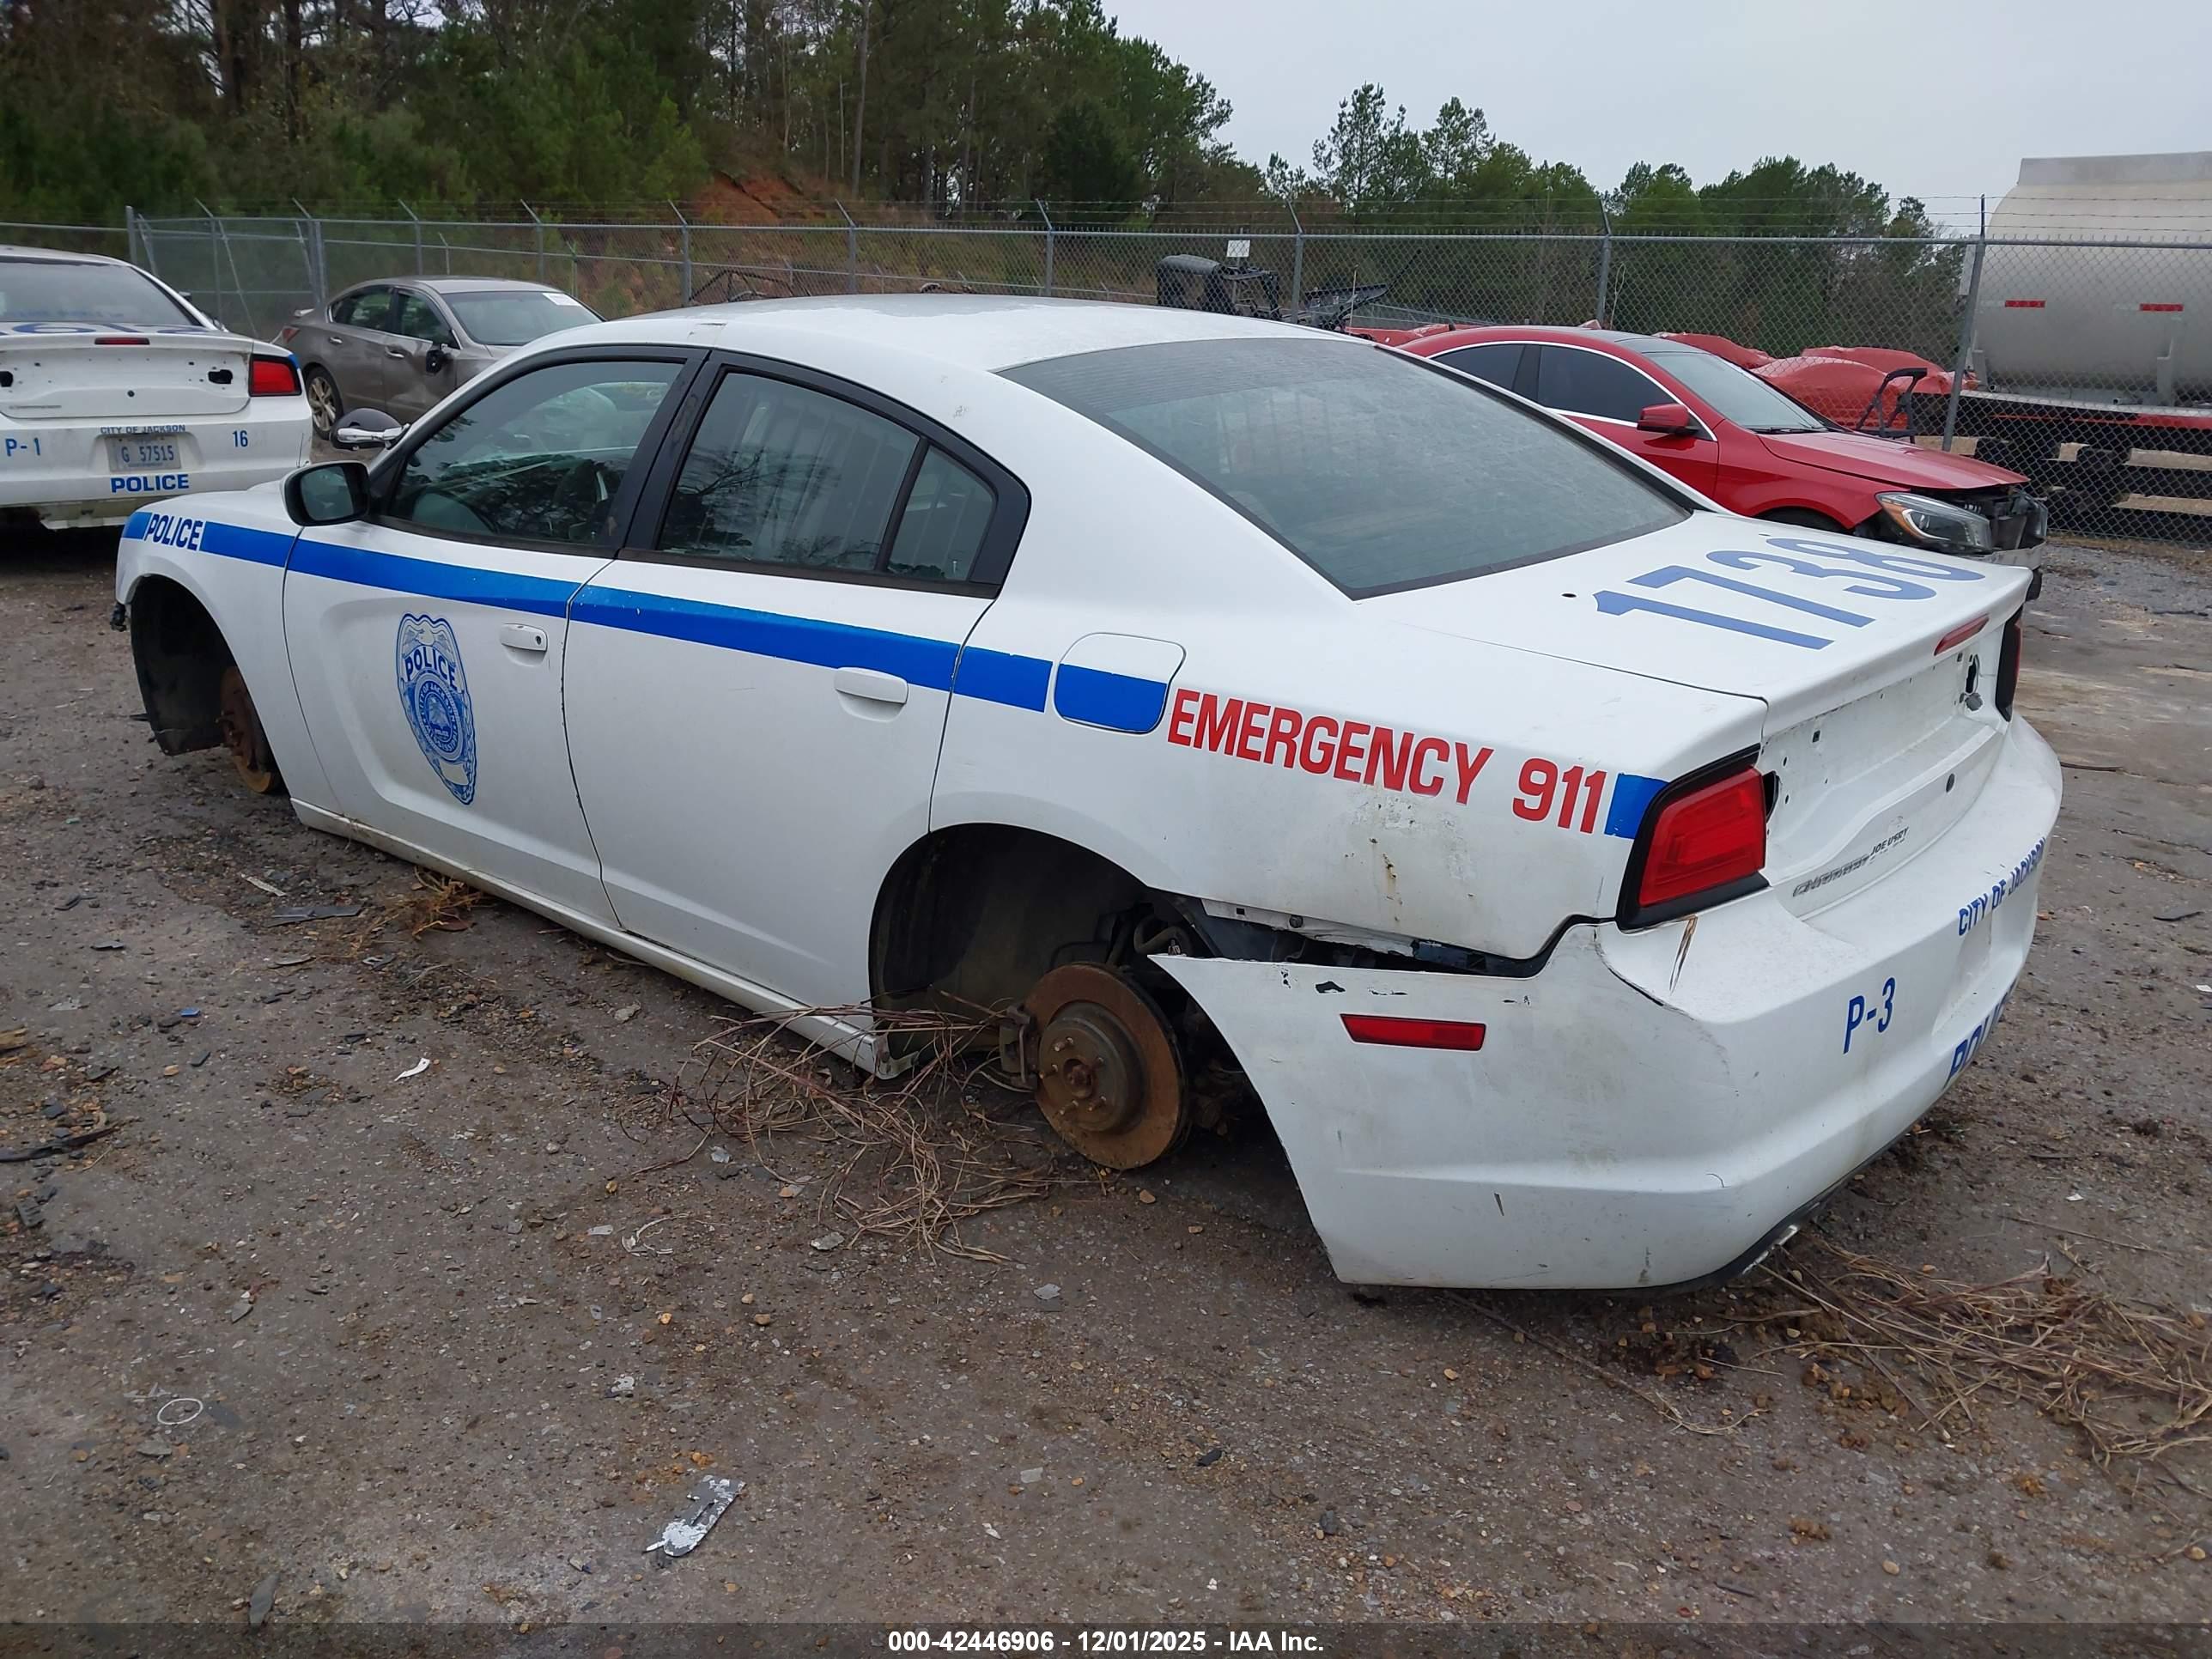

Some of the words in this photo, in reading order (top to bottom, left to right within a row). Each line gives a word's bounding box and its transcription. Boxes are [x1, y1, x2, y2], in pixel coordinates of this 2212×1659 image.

[143, 424, 185, 433] JACKSON
[232, 430, 248, 447] 16
[5, 438, 41, 457] P-1
[139, 445, 174, 461] 57515
[111, 474, 189, 493] POLICE
[144, 514, 204, 550] POLICE
[1592, 538, 1985, 650] 1738
[404, 648, 458, 691] POLICE
[1167, 689, 1495, 805] EMERGENCY
[1511, 757, 1607, 835] 911
[1869, 840, 1888, 856] JOE
[1959, 893, 1988, 936] CITY
[1992, 879, 2007, 910] OF
[2008, 836, 2046, 896] JACKSON
[1844, 976, 1896, 1054] P-3
